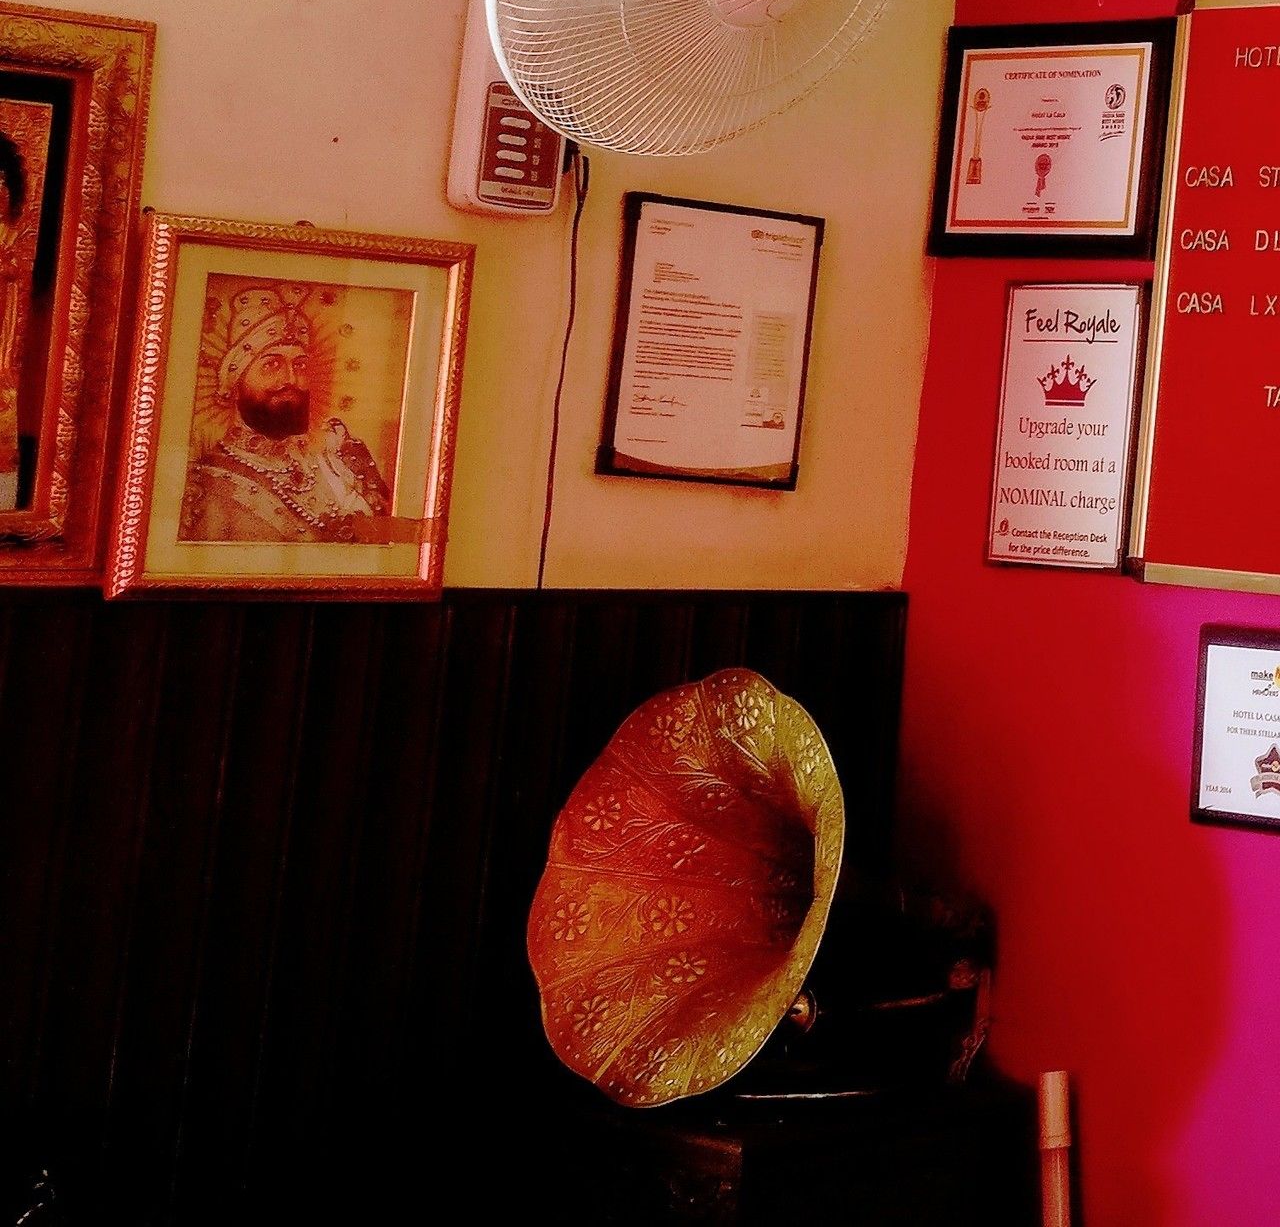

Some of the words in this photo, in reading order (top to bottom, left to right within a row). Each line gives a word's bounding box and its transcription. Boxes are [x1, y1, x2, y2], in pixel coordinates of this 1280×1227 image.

[1185, 167, 1234, 188] CASA
[1180, 230, 1230, 251] CASA
[1177, 292, 1223, 314] CASA
[1025, 308, 1059, 333] Feel
[1063, 309, 1120, 344] Royale
[1019, 417, 1073, 439] Upgrade
[1076, 421, 1108, 440] your
[1005, 452, 1050, 471] booked
[1053, 456, 1088, 472] room
[1092, 458, 1105, 472] at
[1108, 463, 1116, 474] a
[999, 487, 1066, 507] NOMINAL
[1070, 492, 1116, 514] charge
